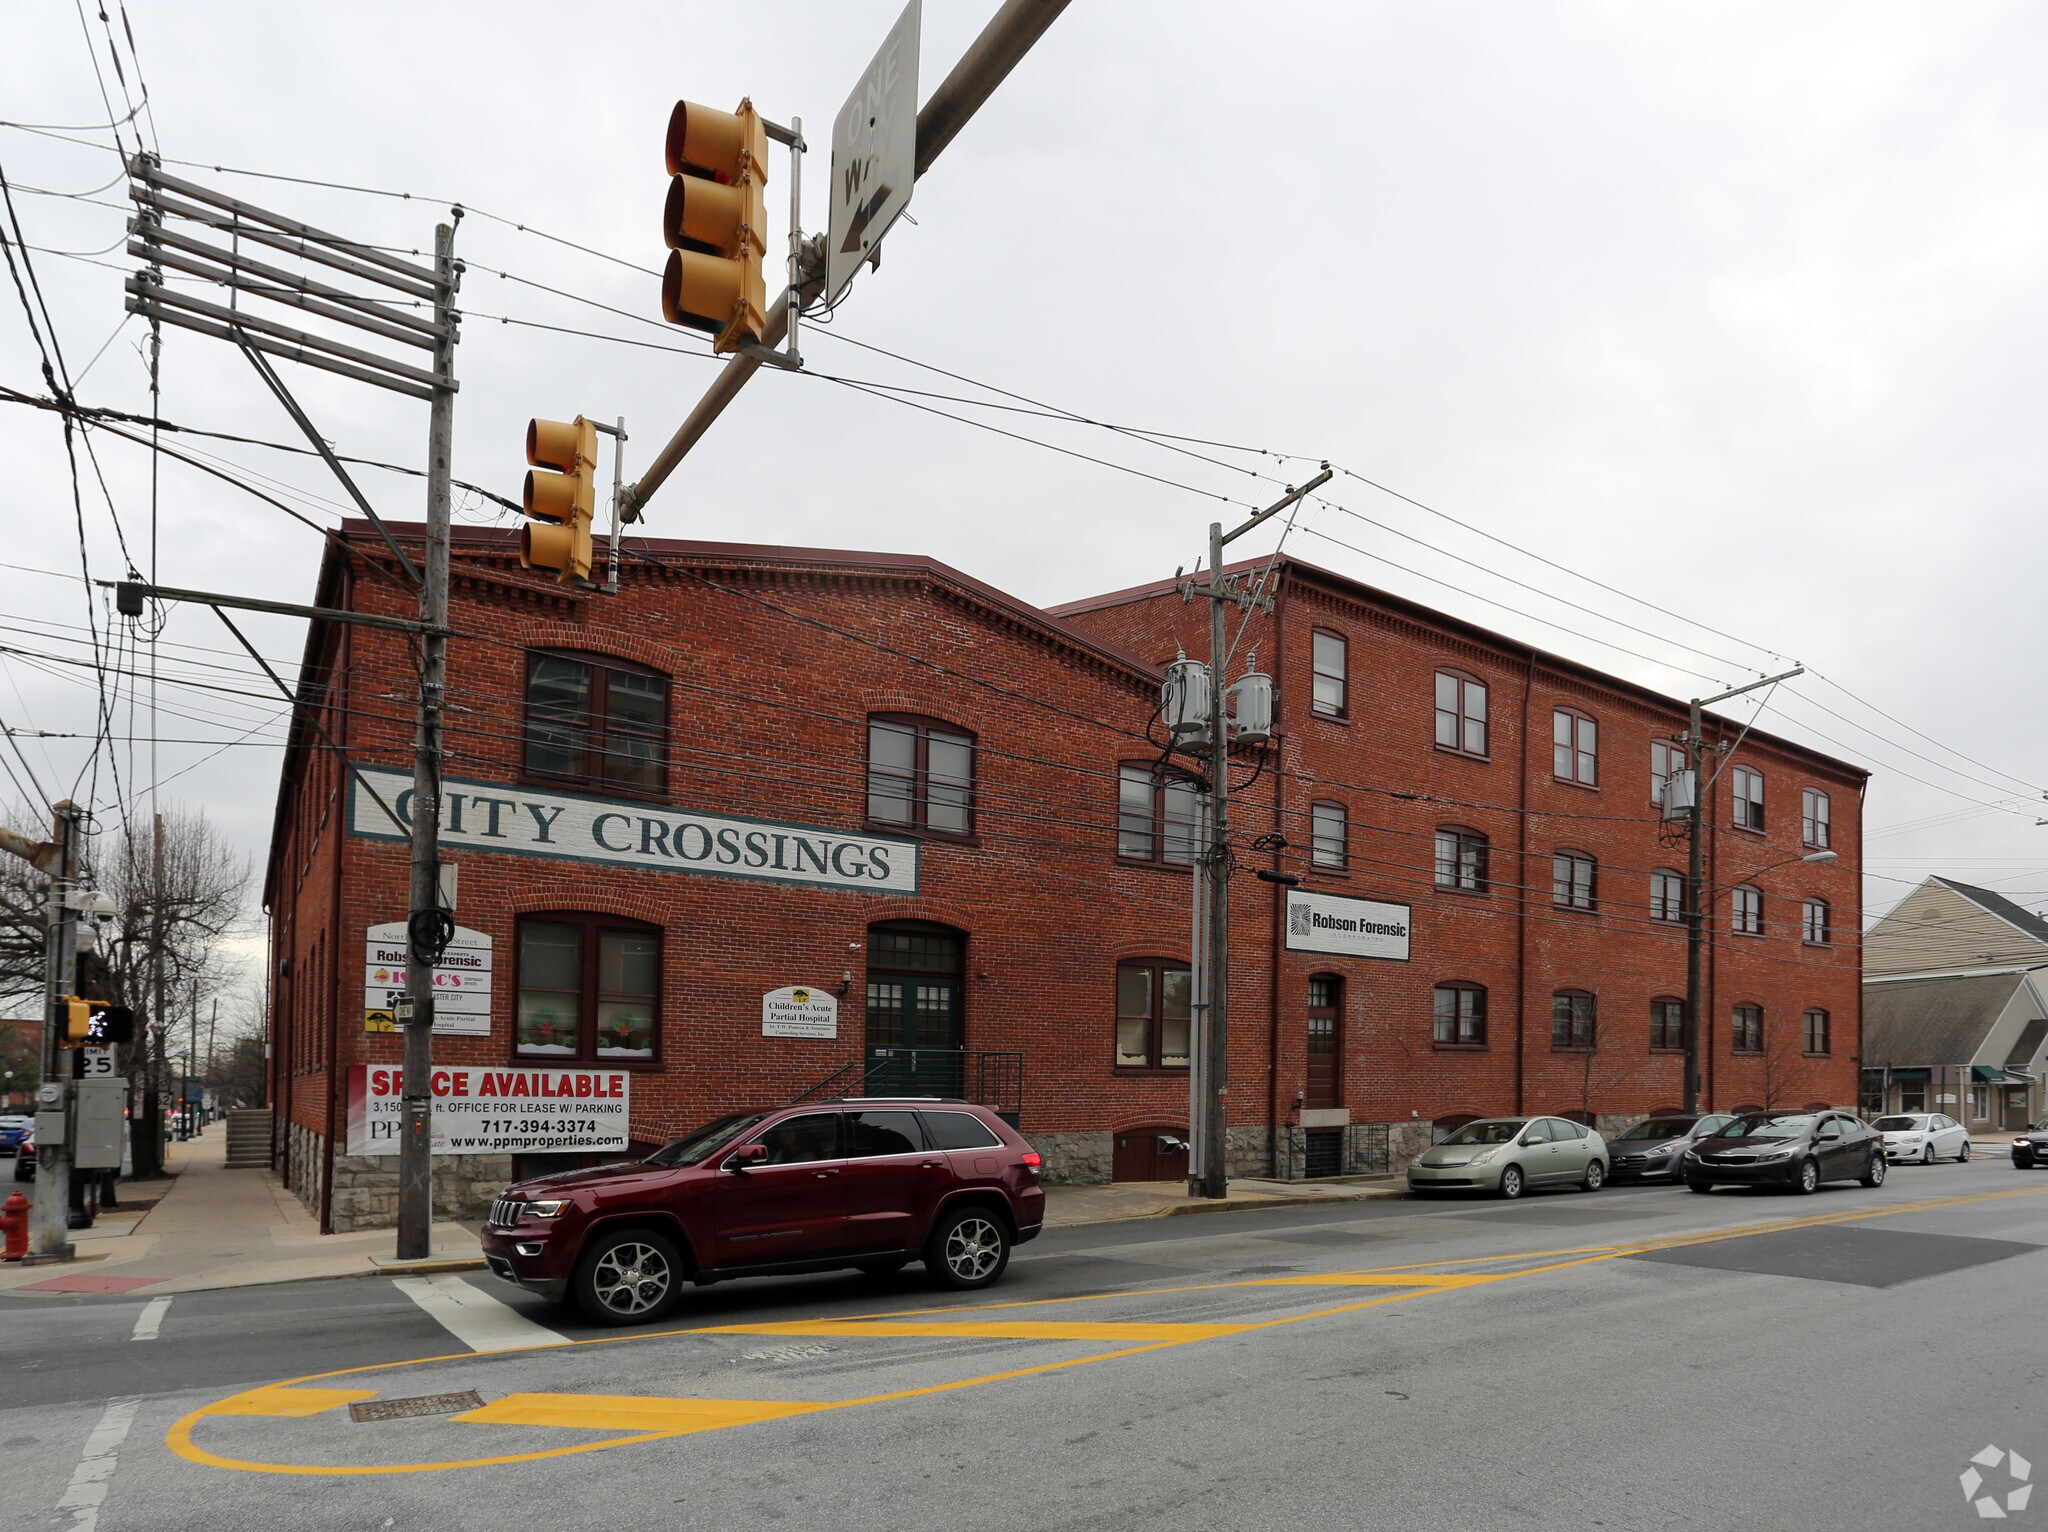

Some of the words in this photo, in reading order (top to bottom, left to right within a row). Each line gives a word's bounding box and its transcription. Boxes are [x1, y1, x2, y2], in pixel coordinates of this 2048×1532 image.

[848, 39, 900, 147] ONE
[591, 812, 891, 881] CROSSINGS
[1312, 912, 1357, 932] Robson
[1359, 918, 1406, 937] Forensic
[452, 937, 478, 946] Street
[768, 1002, 809, 1011] Children's
[811, 1005, 833, 1013] Acute
[770, 1013, 797, 1021] Partial
[799, 1014, 830, 1023] Hospital
[84, 1057, 112, 1073] 25
[371, 1070, 469, 1097] SPCE
[478, 1073, 624, 1098] AVAILABLE
[435, 1103, 445, 1112] ft.
[448, 1102, 490, 1113] OFFICE
[493, 1103, 517, 1113] FOR
[520, 1103, 556, 1113] LEASE
[559, 1104, 573, 1113] W/
[575, 1104, 622, 1114] PARKING
[481, 1120, 596, 1133] 717-394-3374
[450, 1135, 624, 1150] www.ppmproperties.com
